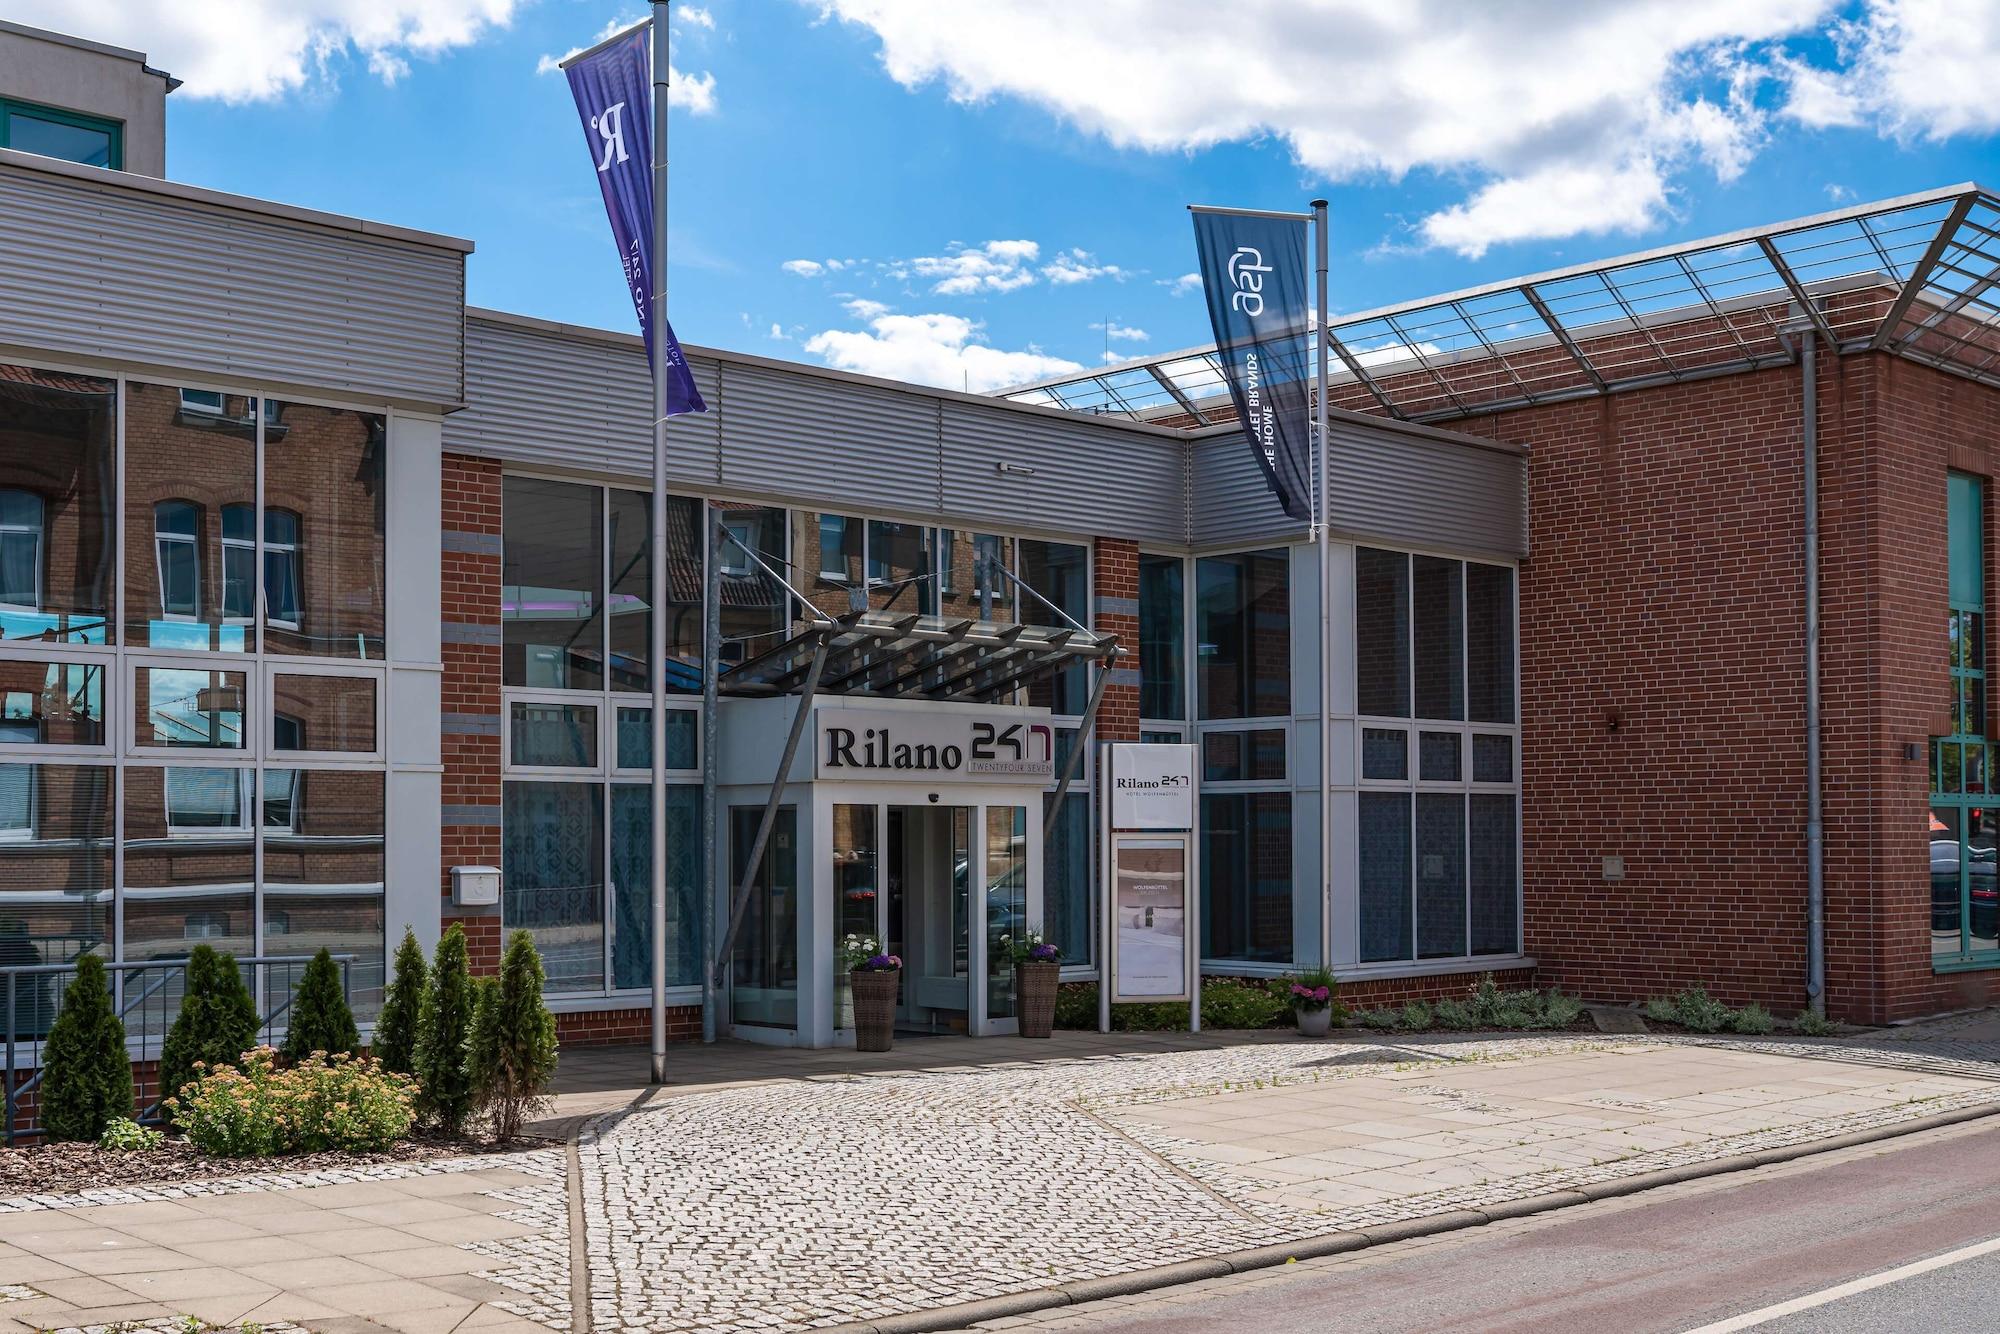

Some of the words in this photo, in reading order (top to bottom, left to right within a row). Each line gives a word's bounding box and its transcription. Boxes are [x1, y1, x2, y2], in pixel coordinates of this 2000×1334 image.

[825, 727, 963, 770] Rilano
[973, 762, 1023, 772] TWENTYFOUR
[1027, 763, 1052, 773] SEVEN
[1116, 778, 1159, 789] Rilano
